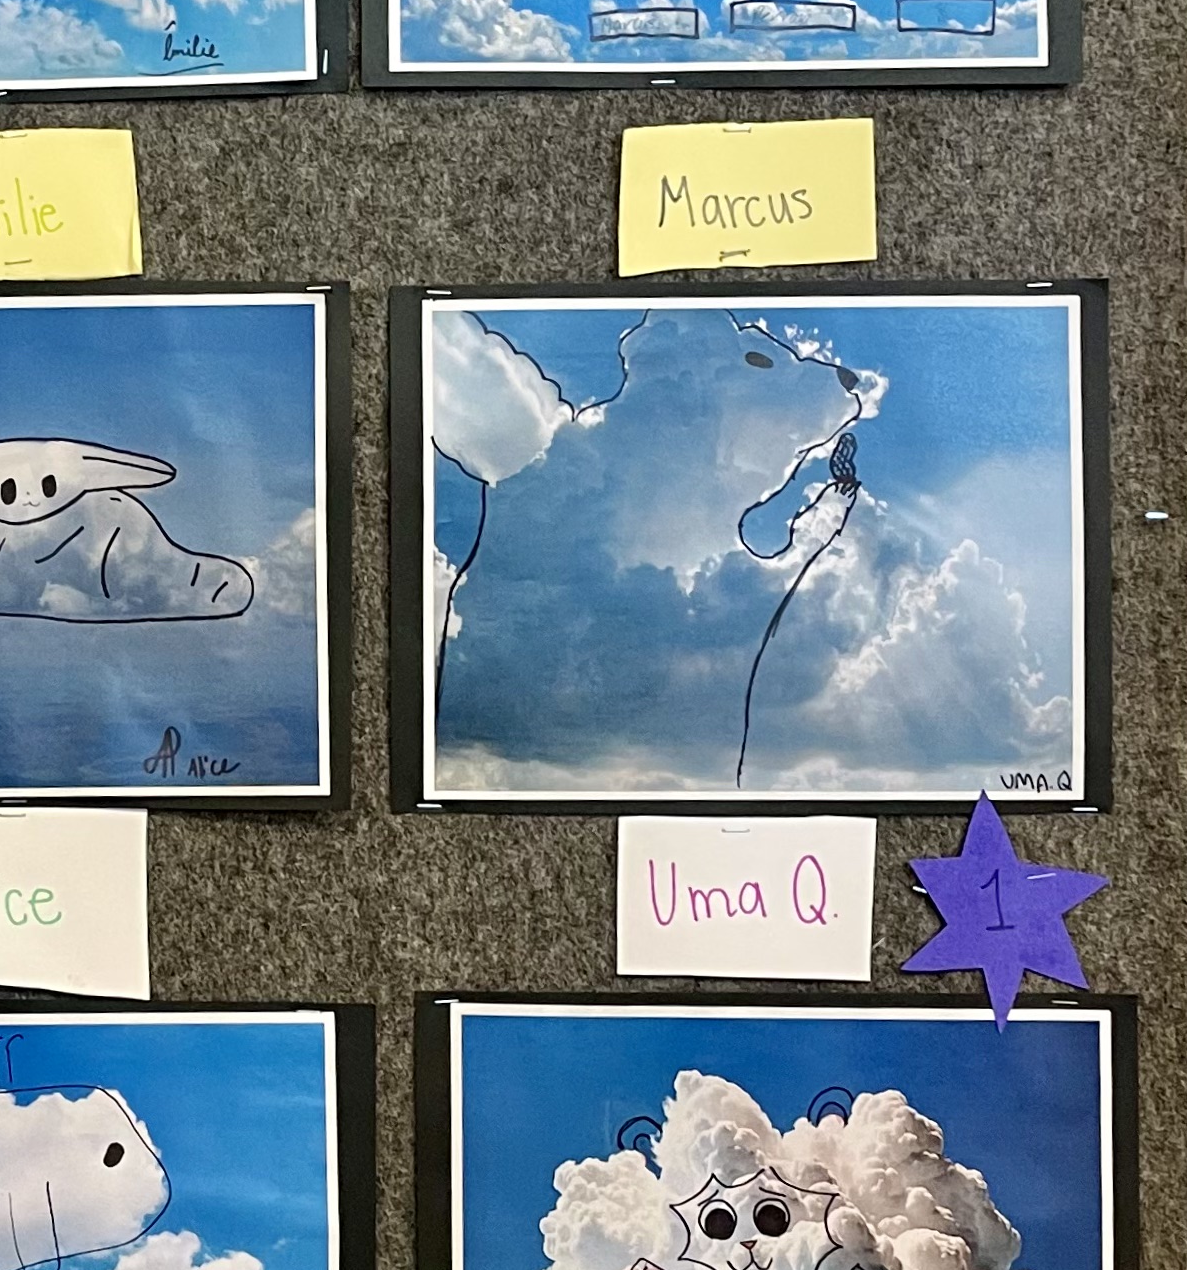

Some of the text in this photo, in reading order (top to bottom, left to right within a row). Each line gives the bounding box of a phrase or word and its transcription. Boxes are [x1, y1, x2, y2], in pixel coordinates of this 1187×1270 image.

[658, 175, 813, 229] Marcus
[649, 854, 838, 926] Uma Q.
[979, 868, 1016, 932] 1
